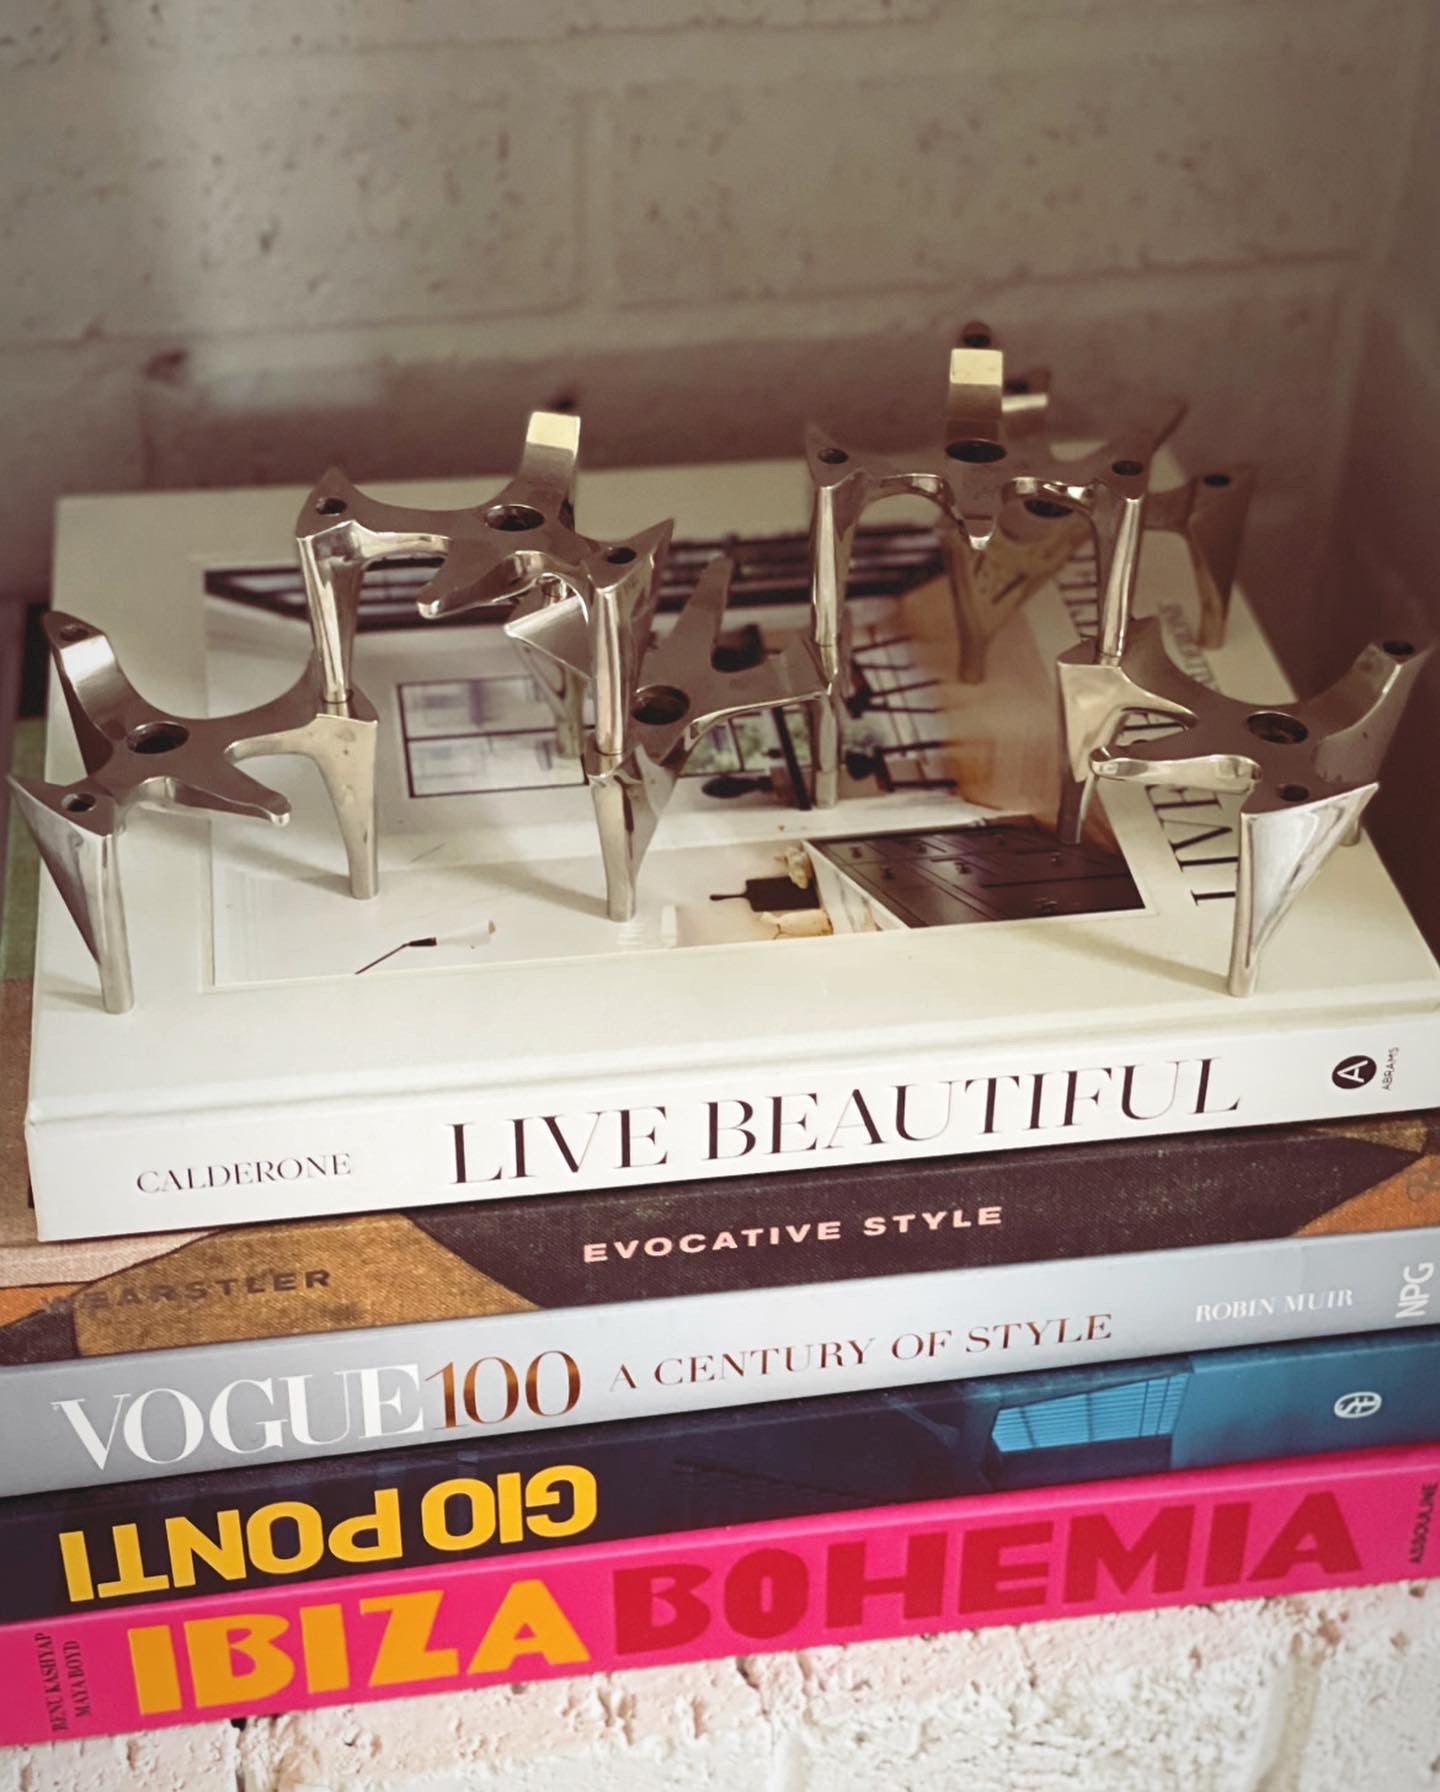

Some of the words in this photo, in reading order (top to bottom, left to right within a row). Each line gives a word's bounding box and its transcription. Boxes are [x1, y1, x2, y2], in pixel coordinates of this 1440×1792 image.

[1381, 1047, 1399, 1091] ABRAMS
[447, 1105, 668, 1186] LIVE
[701, 1057, 1241, 1161] BEAUTIFUL
[137, 1152, 352, 1194] CALDERONE
[583, 1219, 842, 1264] EVOCATIVE
[863, 1206, 1003, 1237] STYLE
[1194, 1298, 1276, 1324] ROBIN
[1284, 1288, 1354, 1313] MUIR
[1395, 1262, 1435, 1318] NPG
[609, 1363, 637, 1392] A
[654, 1337, 876, 1386] CENTURY
[890, 1330, 953, 1360] OF
[966, 1314, 1113, 1352] STYLE
[420, 1465, 598, 1552] GIO
[1408, 1482, 1438, 1564] ASSOULINE
[58, 1488, 403, 1602] PONTI
[127, 1579, 590, 1716] IBIZA
[612, 1491, 1362, 1658] BOHEMIA
[34, 1632, 61, 1693] KASHYAP
[63, 1641, 84, 1678] BOYD
[71, 1680, 91, 1717] MAYA
